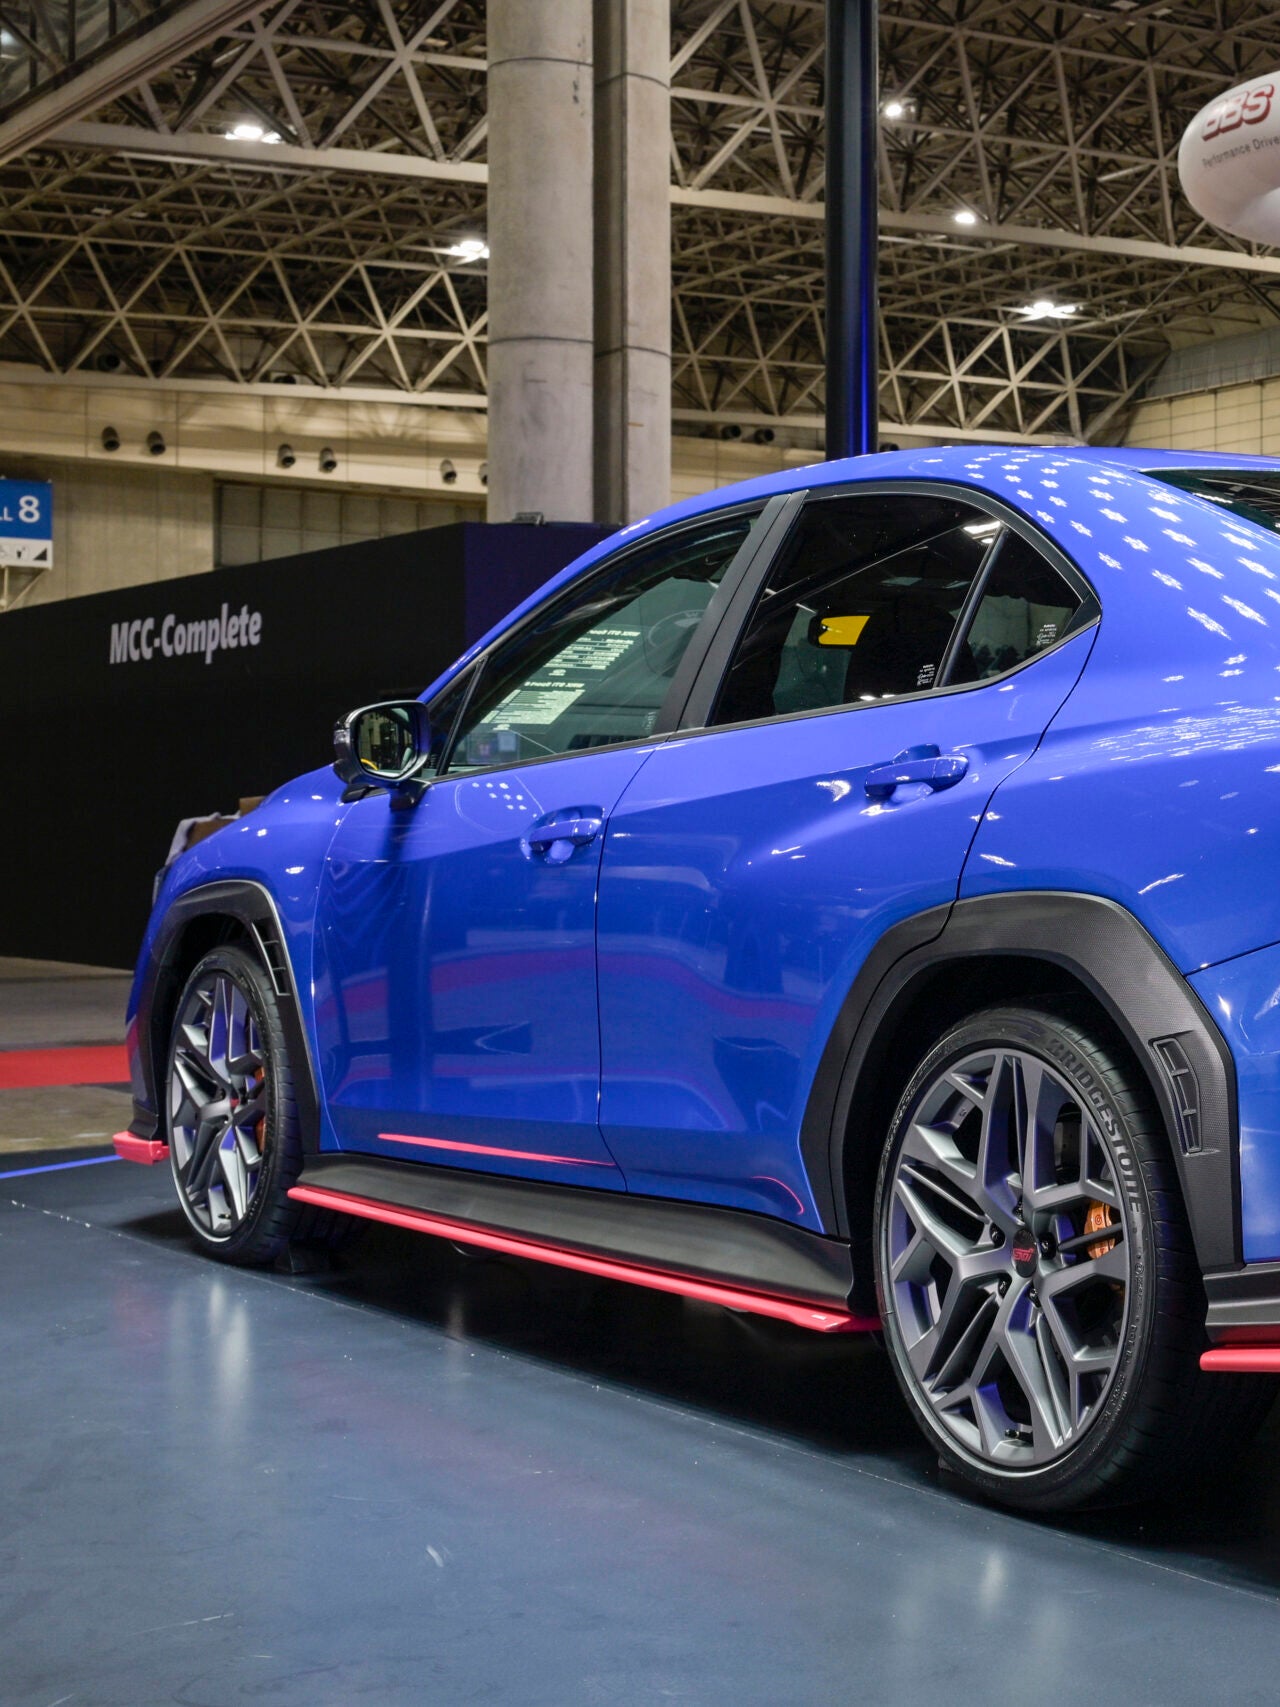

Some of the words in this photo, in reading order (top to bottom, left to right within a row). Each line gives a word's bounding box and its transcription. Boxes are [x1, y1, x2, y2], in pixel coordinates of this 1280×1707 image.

[1202, 143, 1251, 168] Performance
[18, 494, 41, 524] 8
[109, 602, 263, 665] MCC-Complete
[1045, 1040, 1145, 1216] BRIDGESTONE
